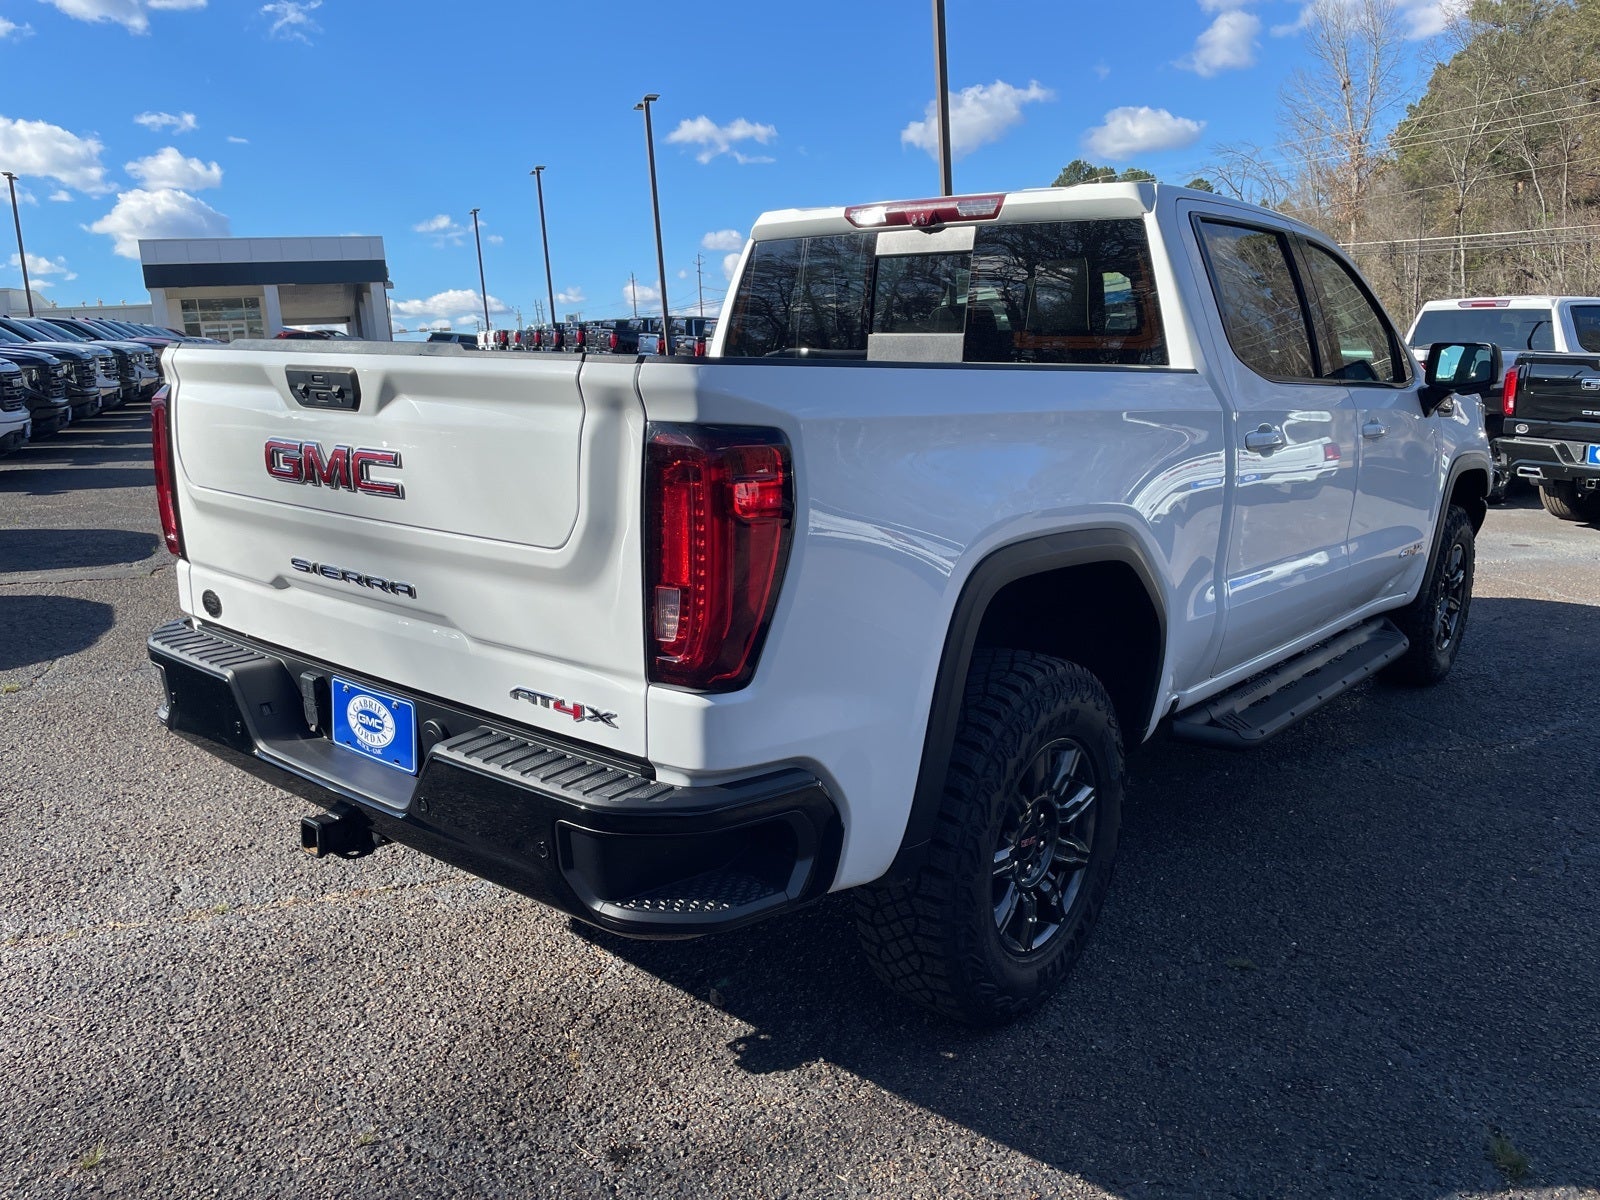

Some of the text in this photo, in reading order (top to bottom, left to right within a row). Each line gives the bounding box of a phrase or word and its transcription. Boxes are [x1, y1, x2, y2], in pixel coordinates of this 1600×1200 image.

[264, 435, 406, 500] GMC
[290, 556, 418, 599] SIERRA
[353, 699, 387, 720] GABRIEL
[358, 713, 383, 730] GMC
[509, 685, 620, 730] AT4X
[352, 722, 389, 744] JORDAN
